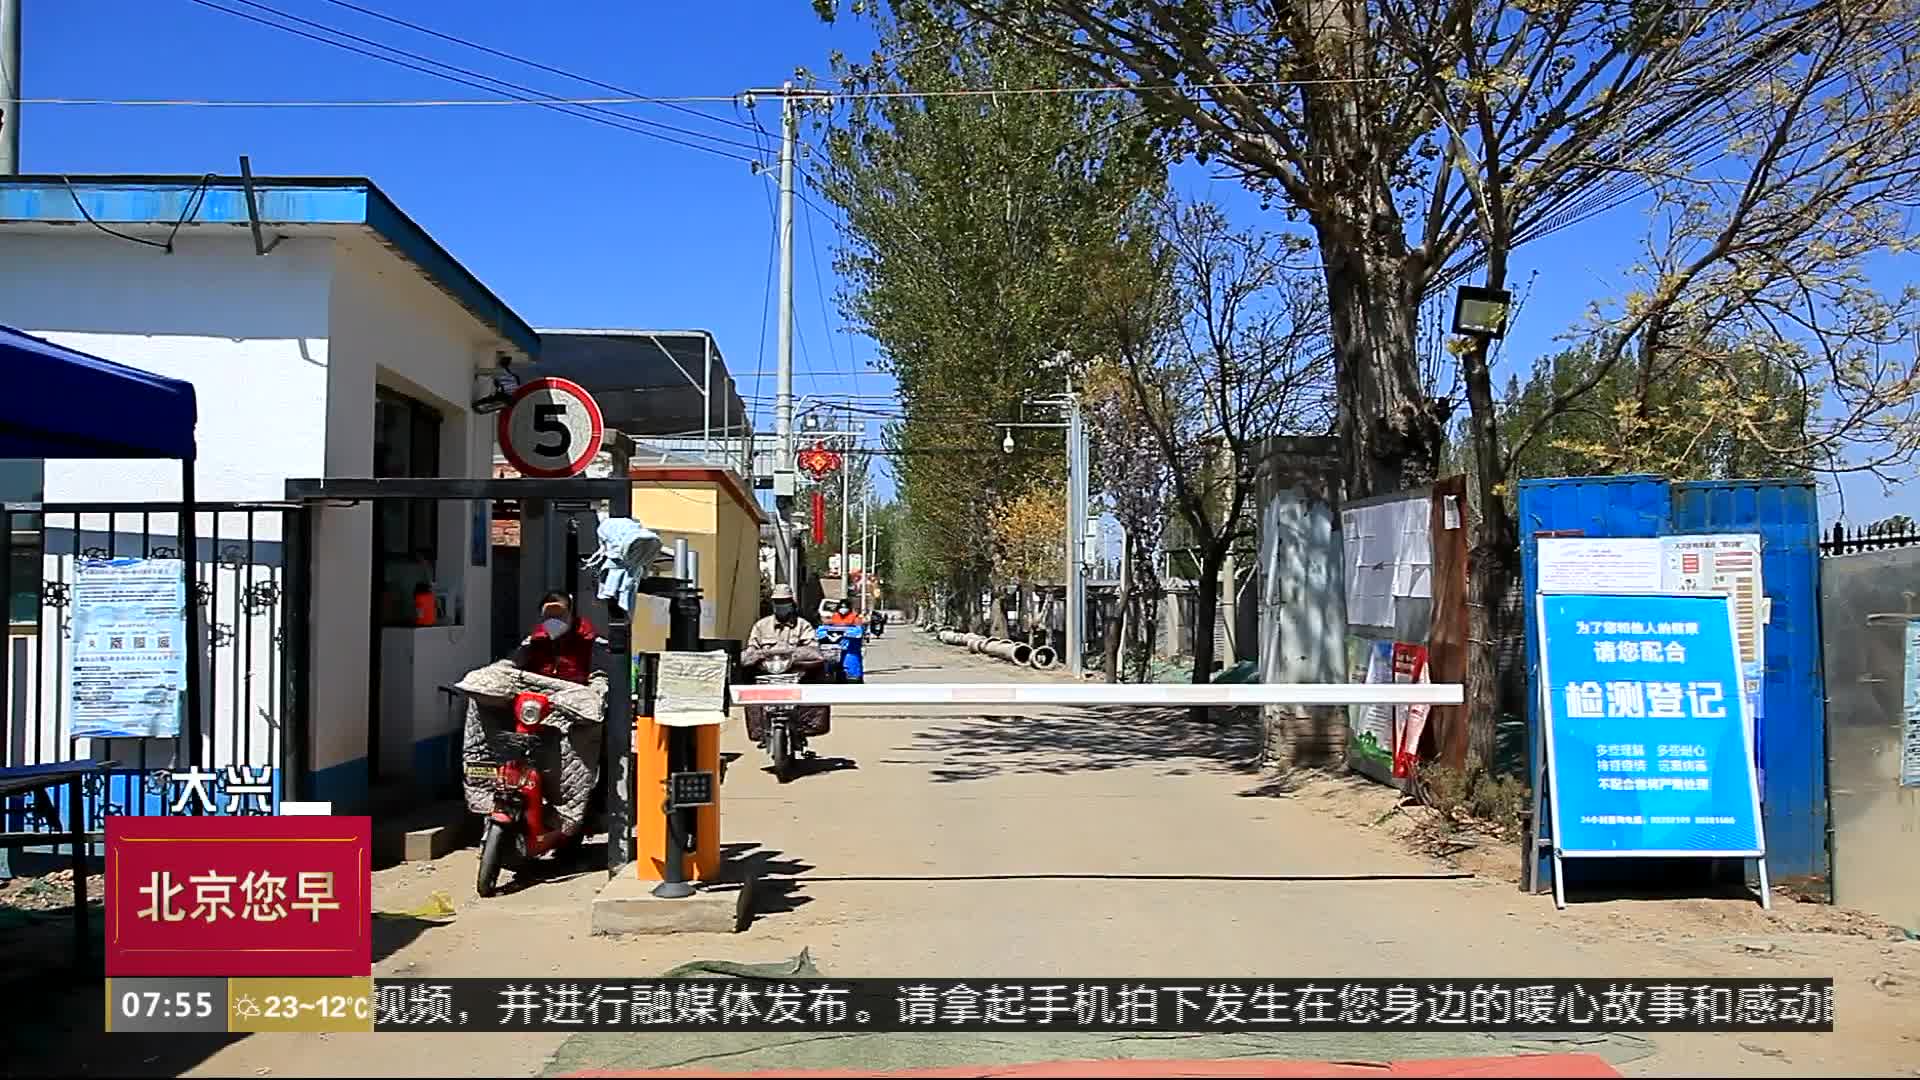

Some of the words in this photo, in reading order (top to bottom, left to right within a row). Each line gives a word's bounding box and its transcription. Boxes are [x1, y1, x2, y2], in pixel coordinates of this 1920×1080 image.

[533, 404, 571, 458] 5
[1593, 640, 1686, 664] 请您配合
[1565, 681, 1727, 718] 检测登记
